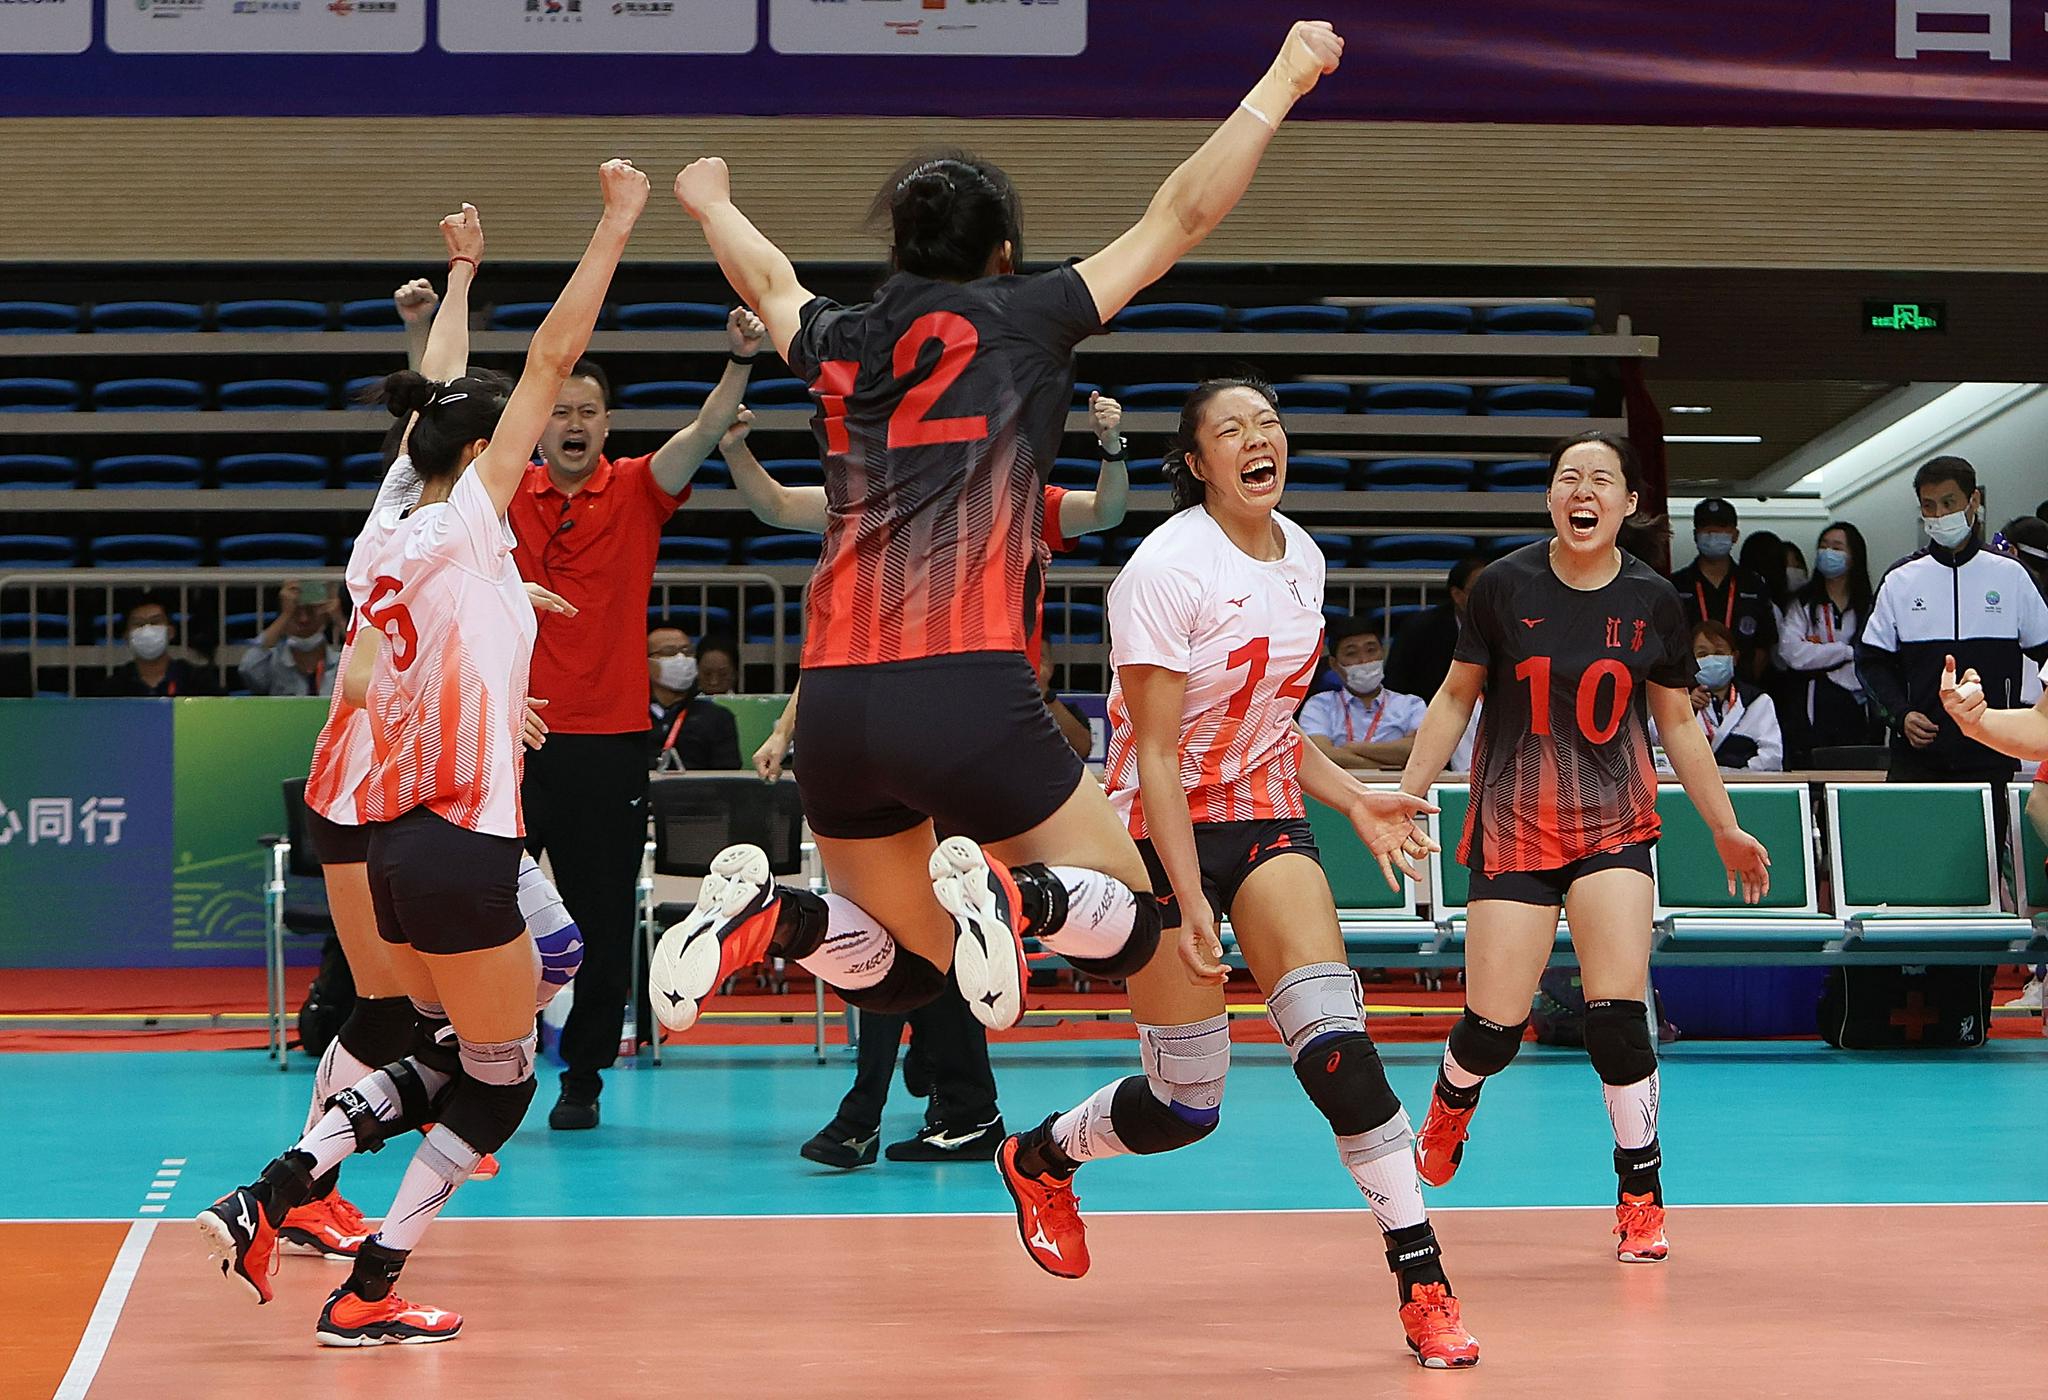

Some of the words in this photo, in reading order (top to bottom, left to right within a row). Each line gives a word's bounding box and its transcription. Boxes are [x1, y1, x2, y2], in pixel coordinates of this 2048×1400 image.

[808, 311, 989, 456] 12
[1224, 628, 1325, 720] 14
[1606, 616, 1646, 652] 江苏
[1515, 656, 1633, 744] 10
